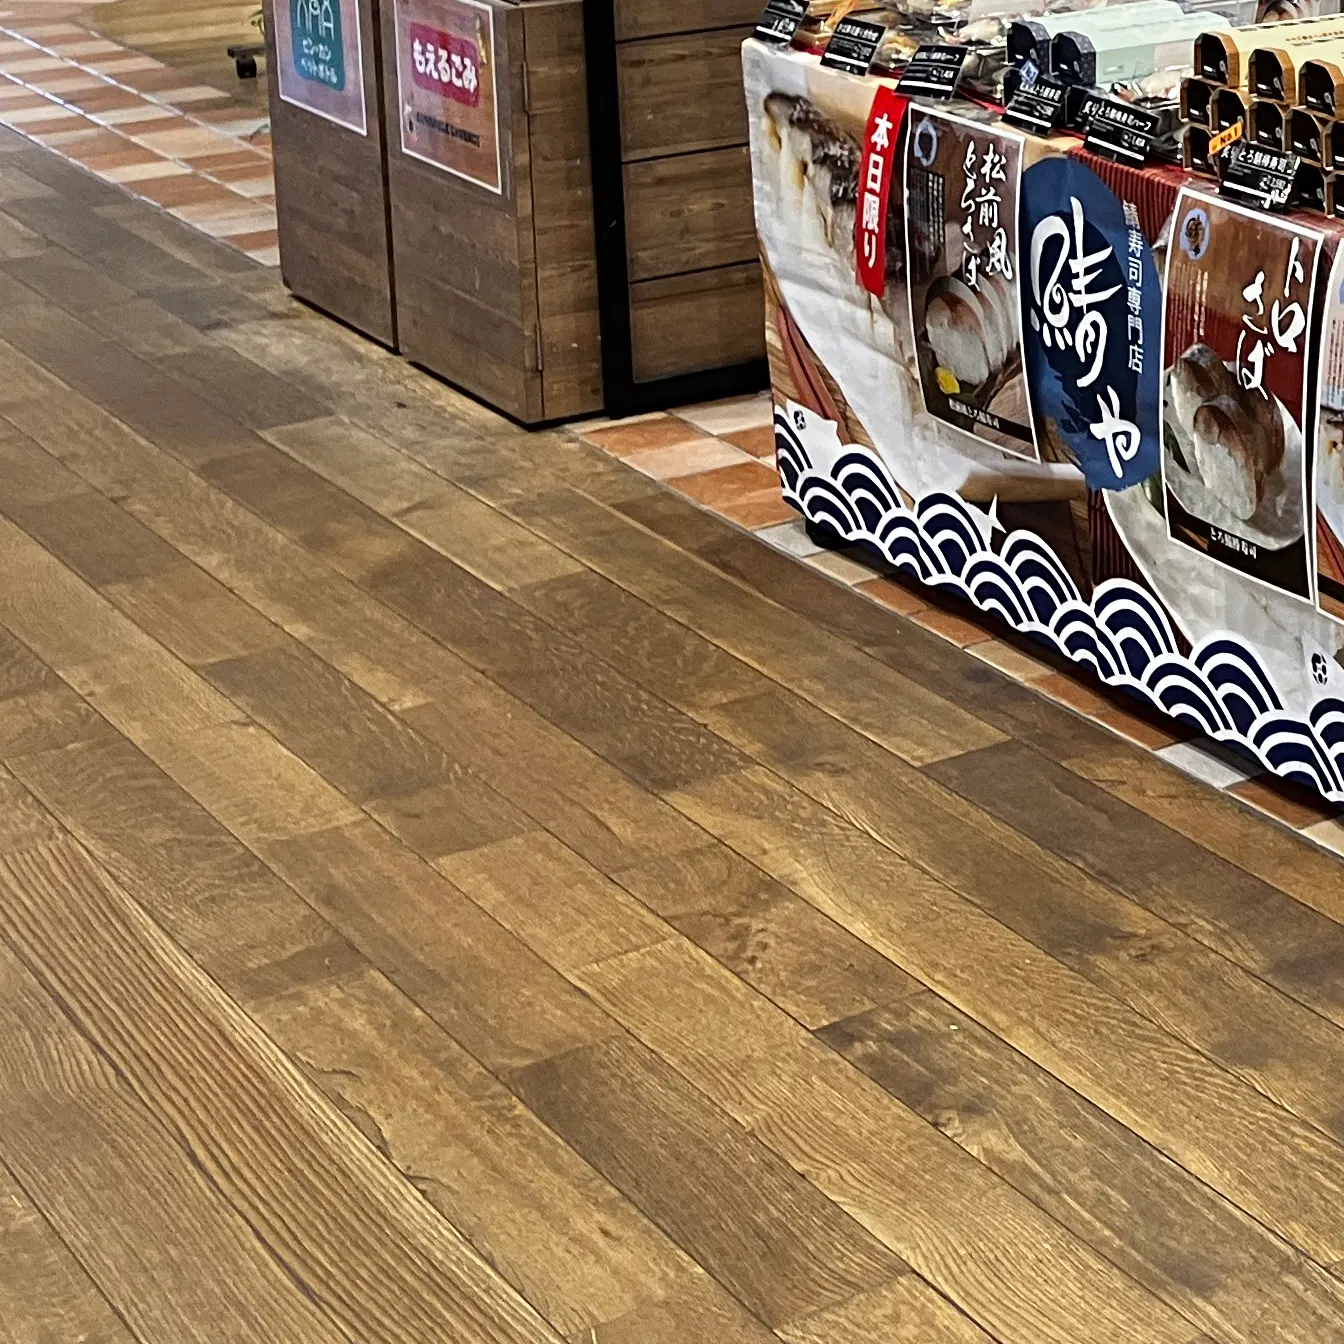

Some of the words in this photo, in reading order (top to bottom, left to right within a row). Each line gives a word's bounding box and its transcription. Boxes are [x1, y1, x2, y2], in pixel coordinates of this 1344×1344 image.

[413, 39, 478, 93] もえるごみ
[862, 113, 894, 268] 本日限り
[979, 143, 1014, 281] 松前風
[1031, 196, 1142, 478] 鯖や
[1122, 200, 1146, 375] 鯖寿司専門店
[1236, 270, 1273, 400] さば
[1271, 237, 1306, 353] トロ
